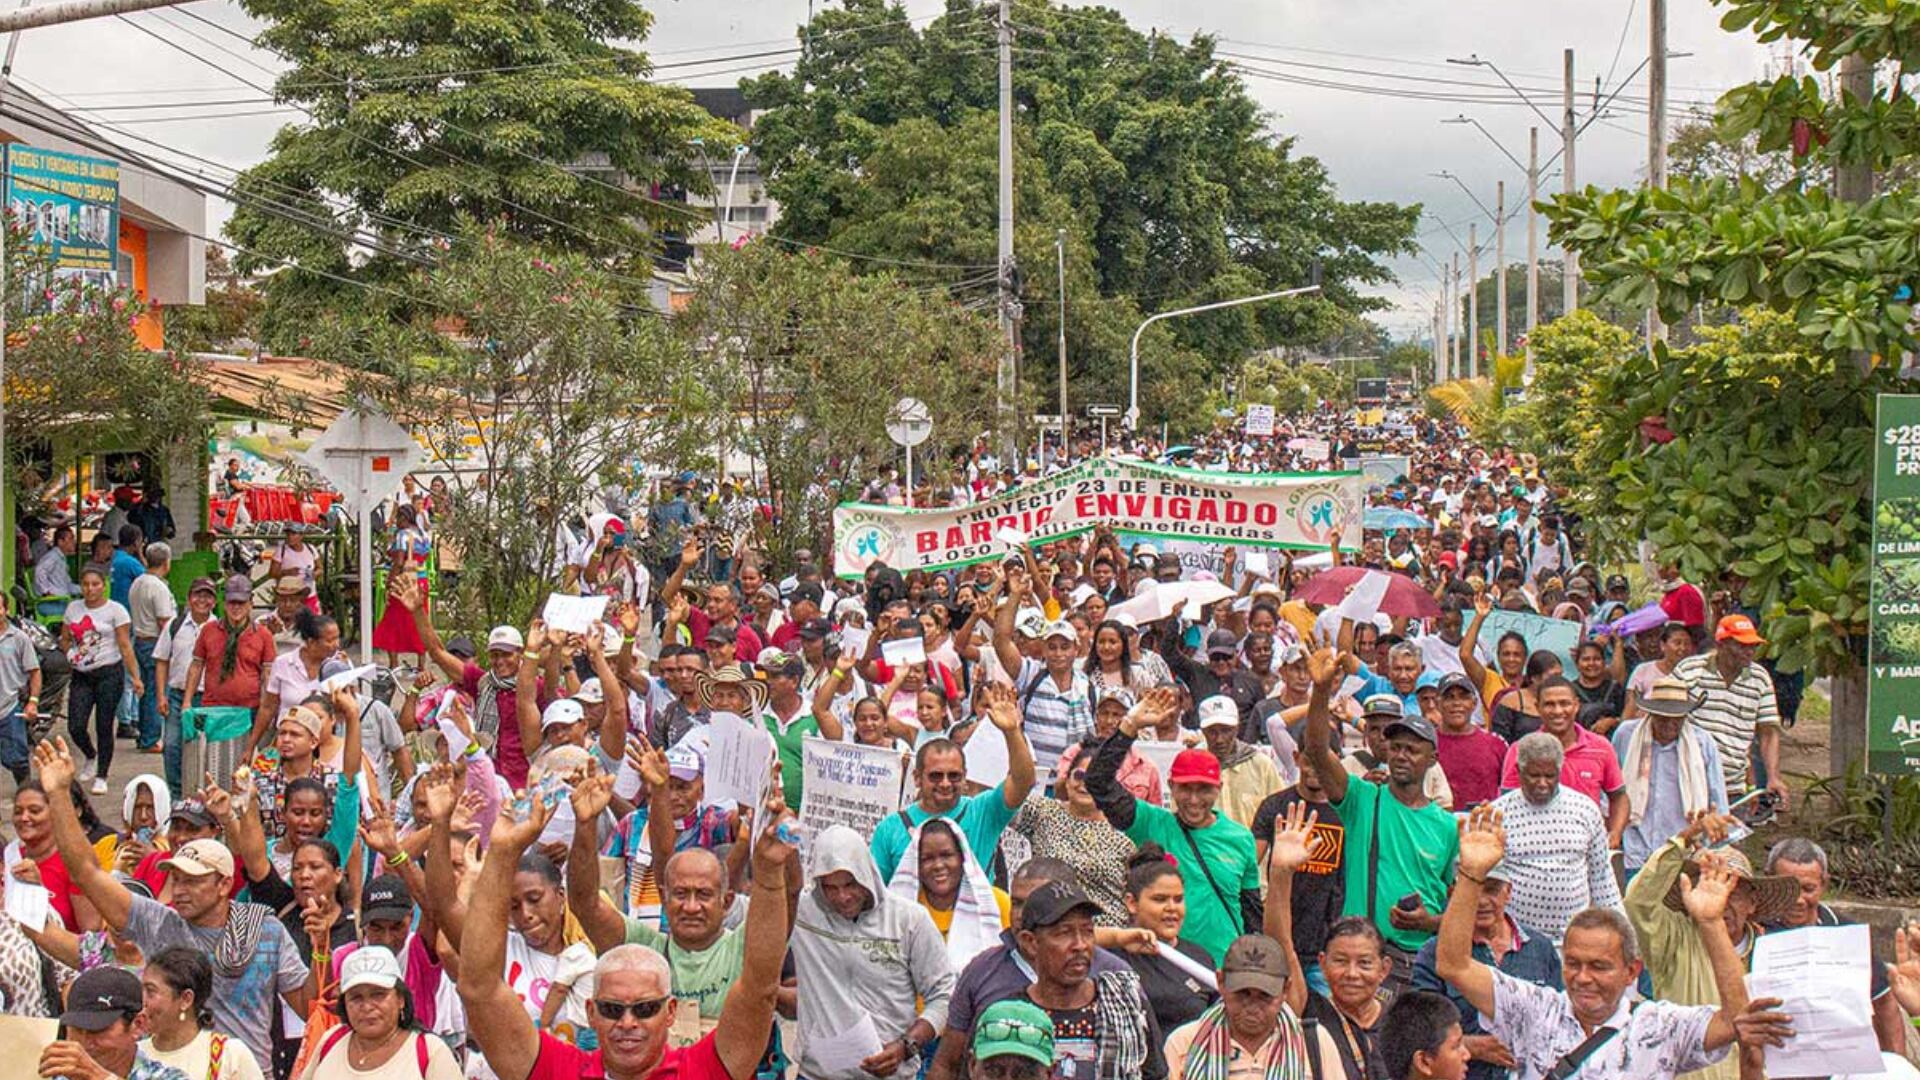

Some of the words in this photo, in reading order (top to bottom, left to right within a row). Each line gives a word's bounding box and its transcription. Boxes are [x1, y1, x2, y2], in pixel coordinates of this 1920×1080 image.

[916, 506, 1053, 553] BARRIO
[1074, 492, 1277, 526] ENVIGADO
[956, 489, 1068, 525] PROYECTO
[1077, 479, 1106, 494] 23
[1119, 480, 1147, 494] DE
[1160, 482, 1233, 499] ENERO
[919, 543, 992, 566] 1.050
[1109, 518, 1275, 540] beneficiadas
[1878, 543, 1896, 554] DE
[1875, 667, 1885, 679] Y
